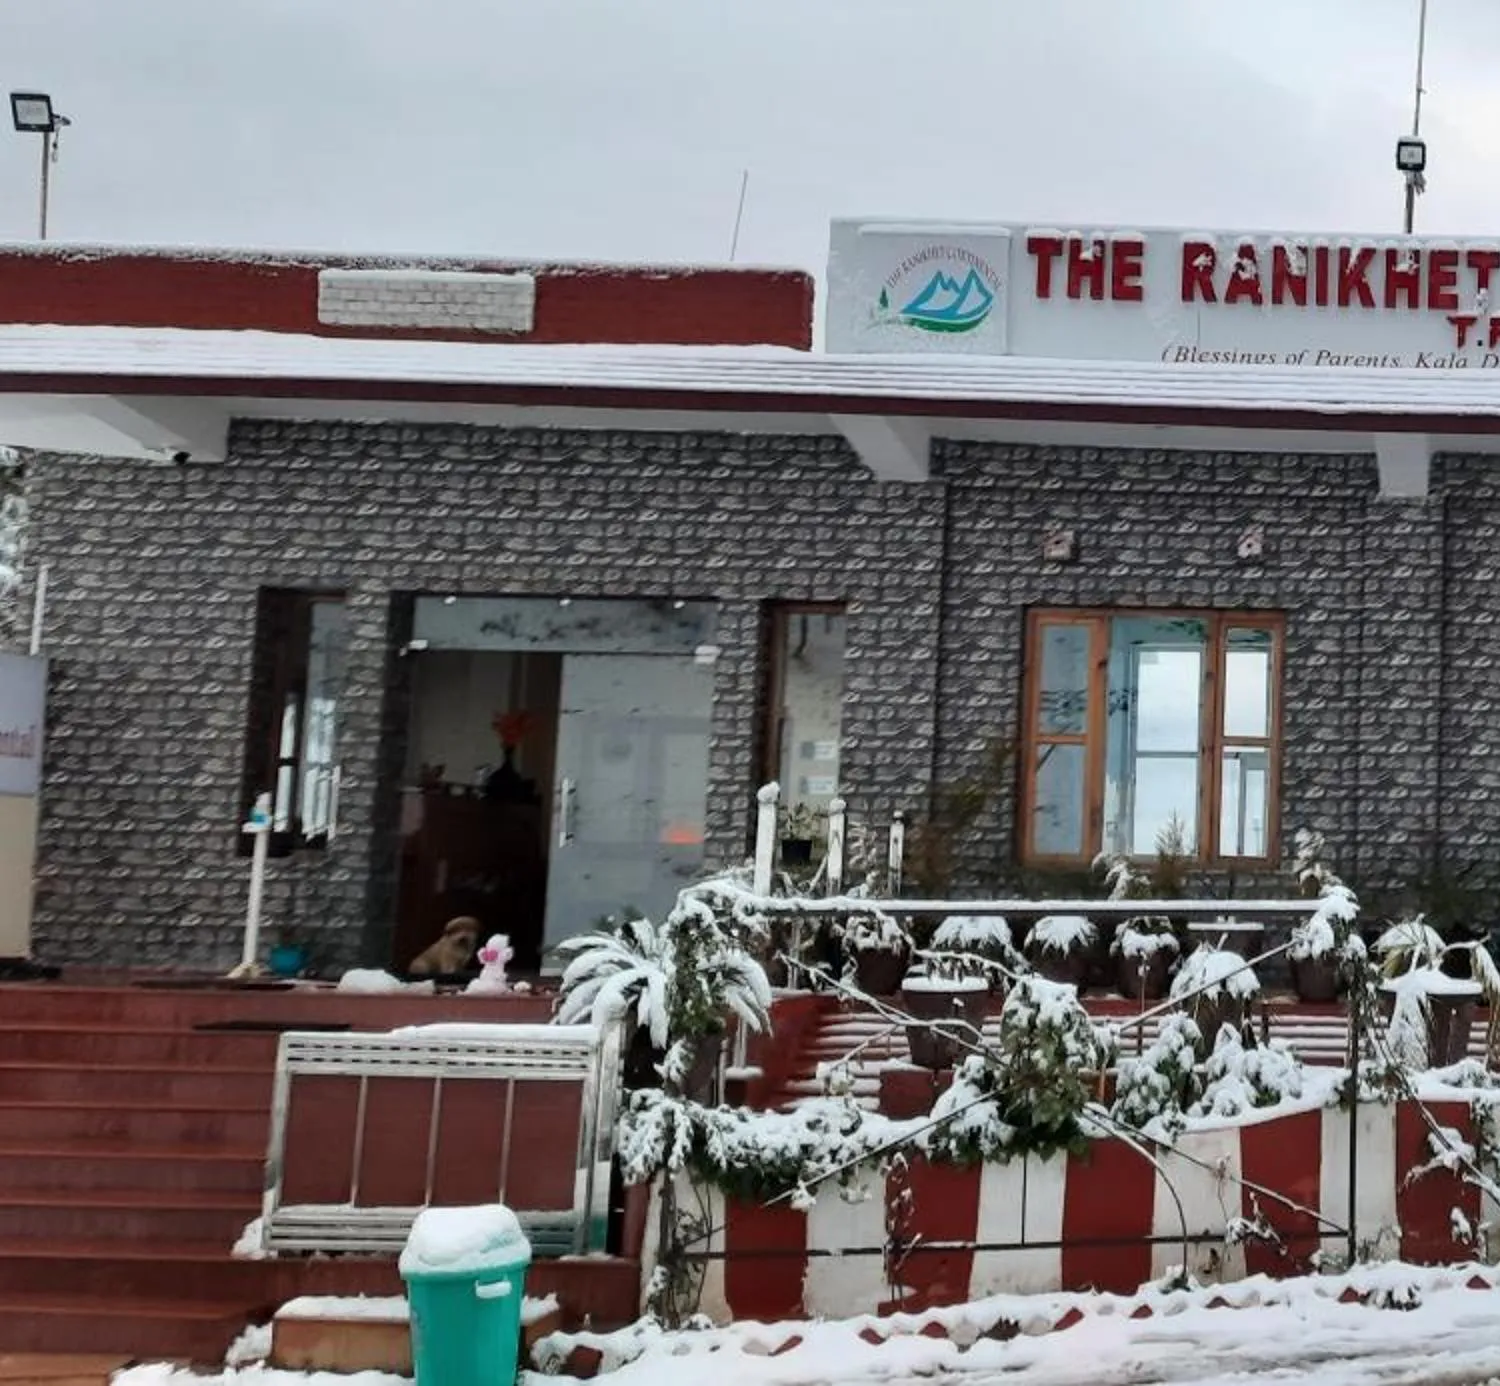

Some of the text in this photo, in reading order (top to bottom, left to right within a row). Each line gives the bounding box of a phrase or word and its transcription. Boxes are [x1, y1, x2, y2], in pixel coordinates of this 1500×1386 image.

[1026, 236, 1145, 301] THE
[1285, 348, 1310, 366] of
[1415, 351, 1469, 369] Kala
